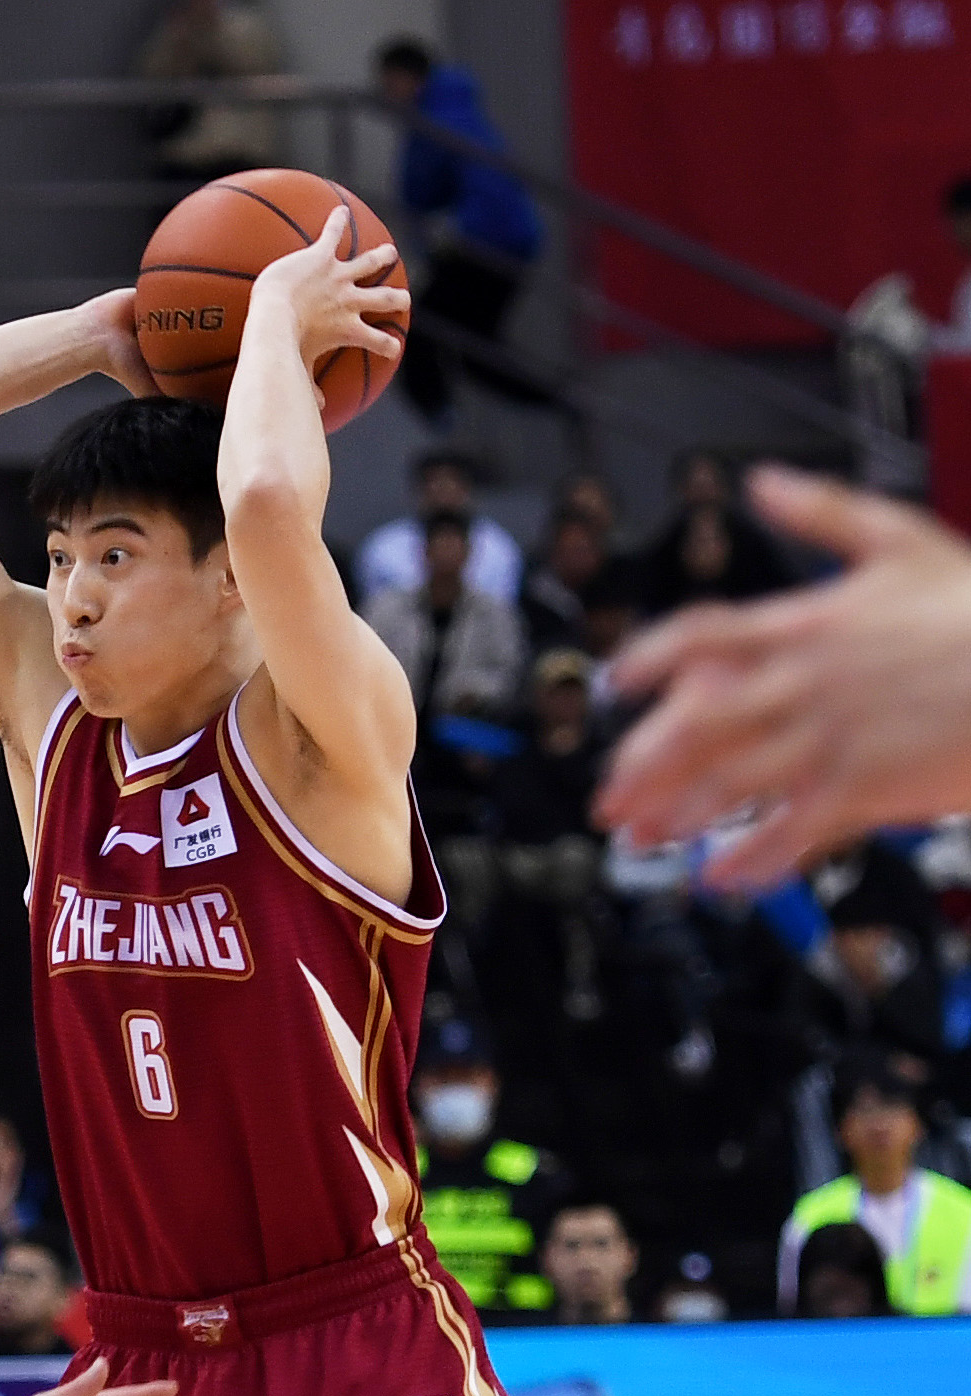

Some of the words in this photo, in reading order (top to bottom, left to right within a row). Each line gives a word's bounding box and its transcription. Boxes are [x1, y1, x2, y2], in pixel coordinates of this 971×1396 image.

[174, 825, 222, 850] 广发银行
[186, 843, 216, 861] CGB
[51, 883, 246, 971] ZHEJIANG
[128, 1017, 173, 1114] 6
